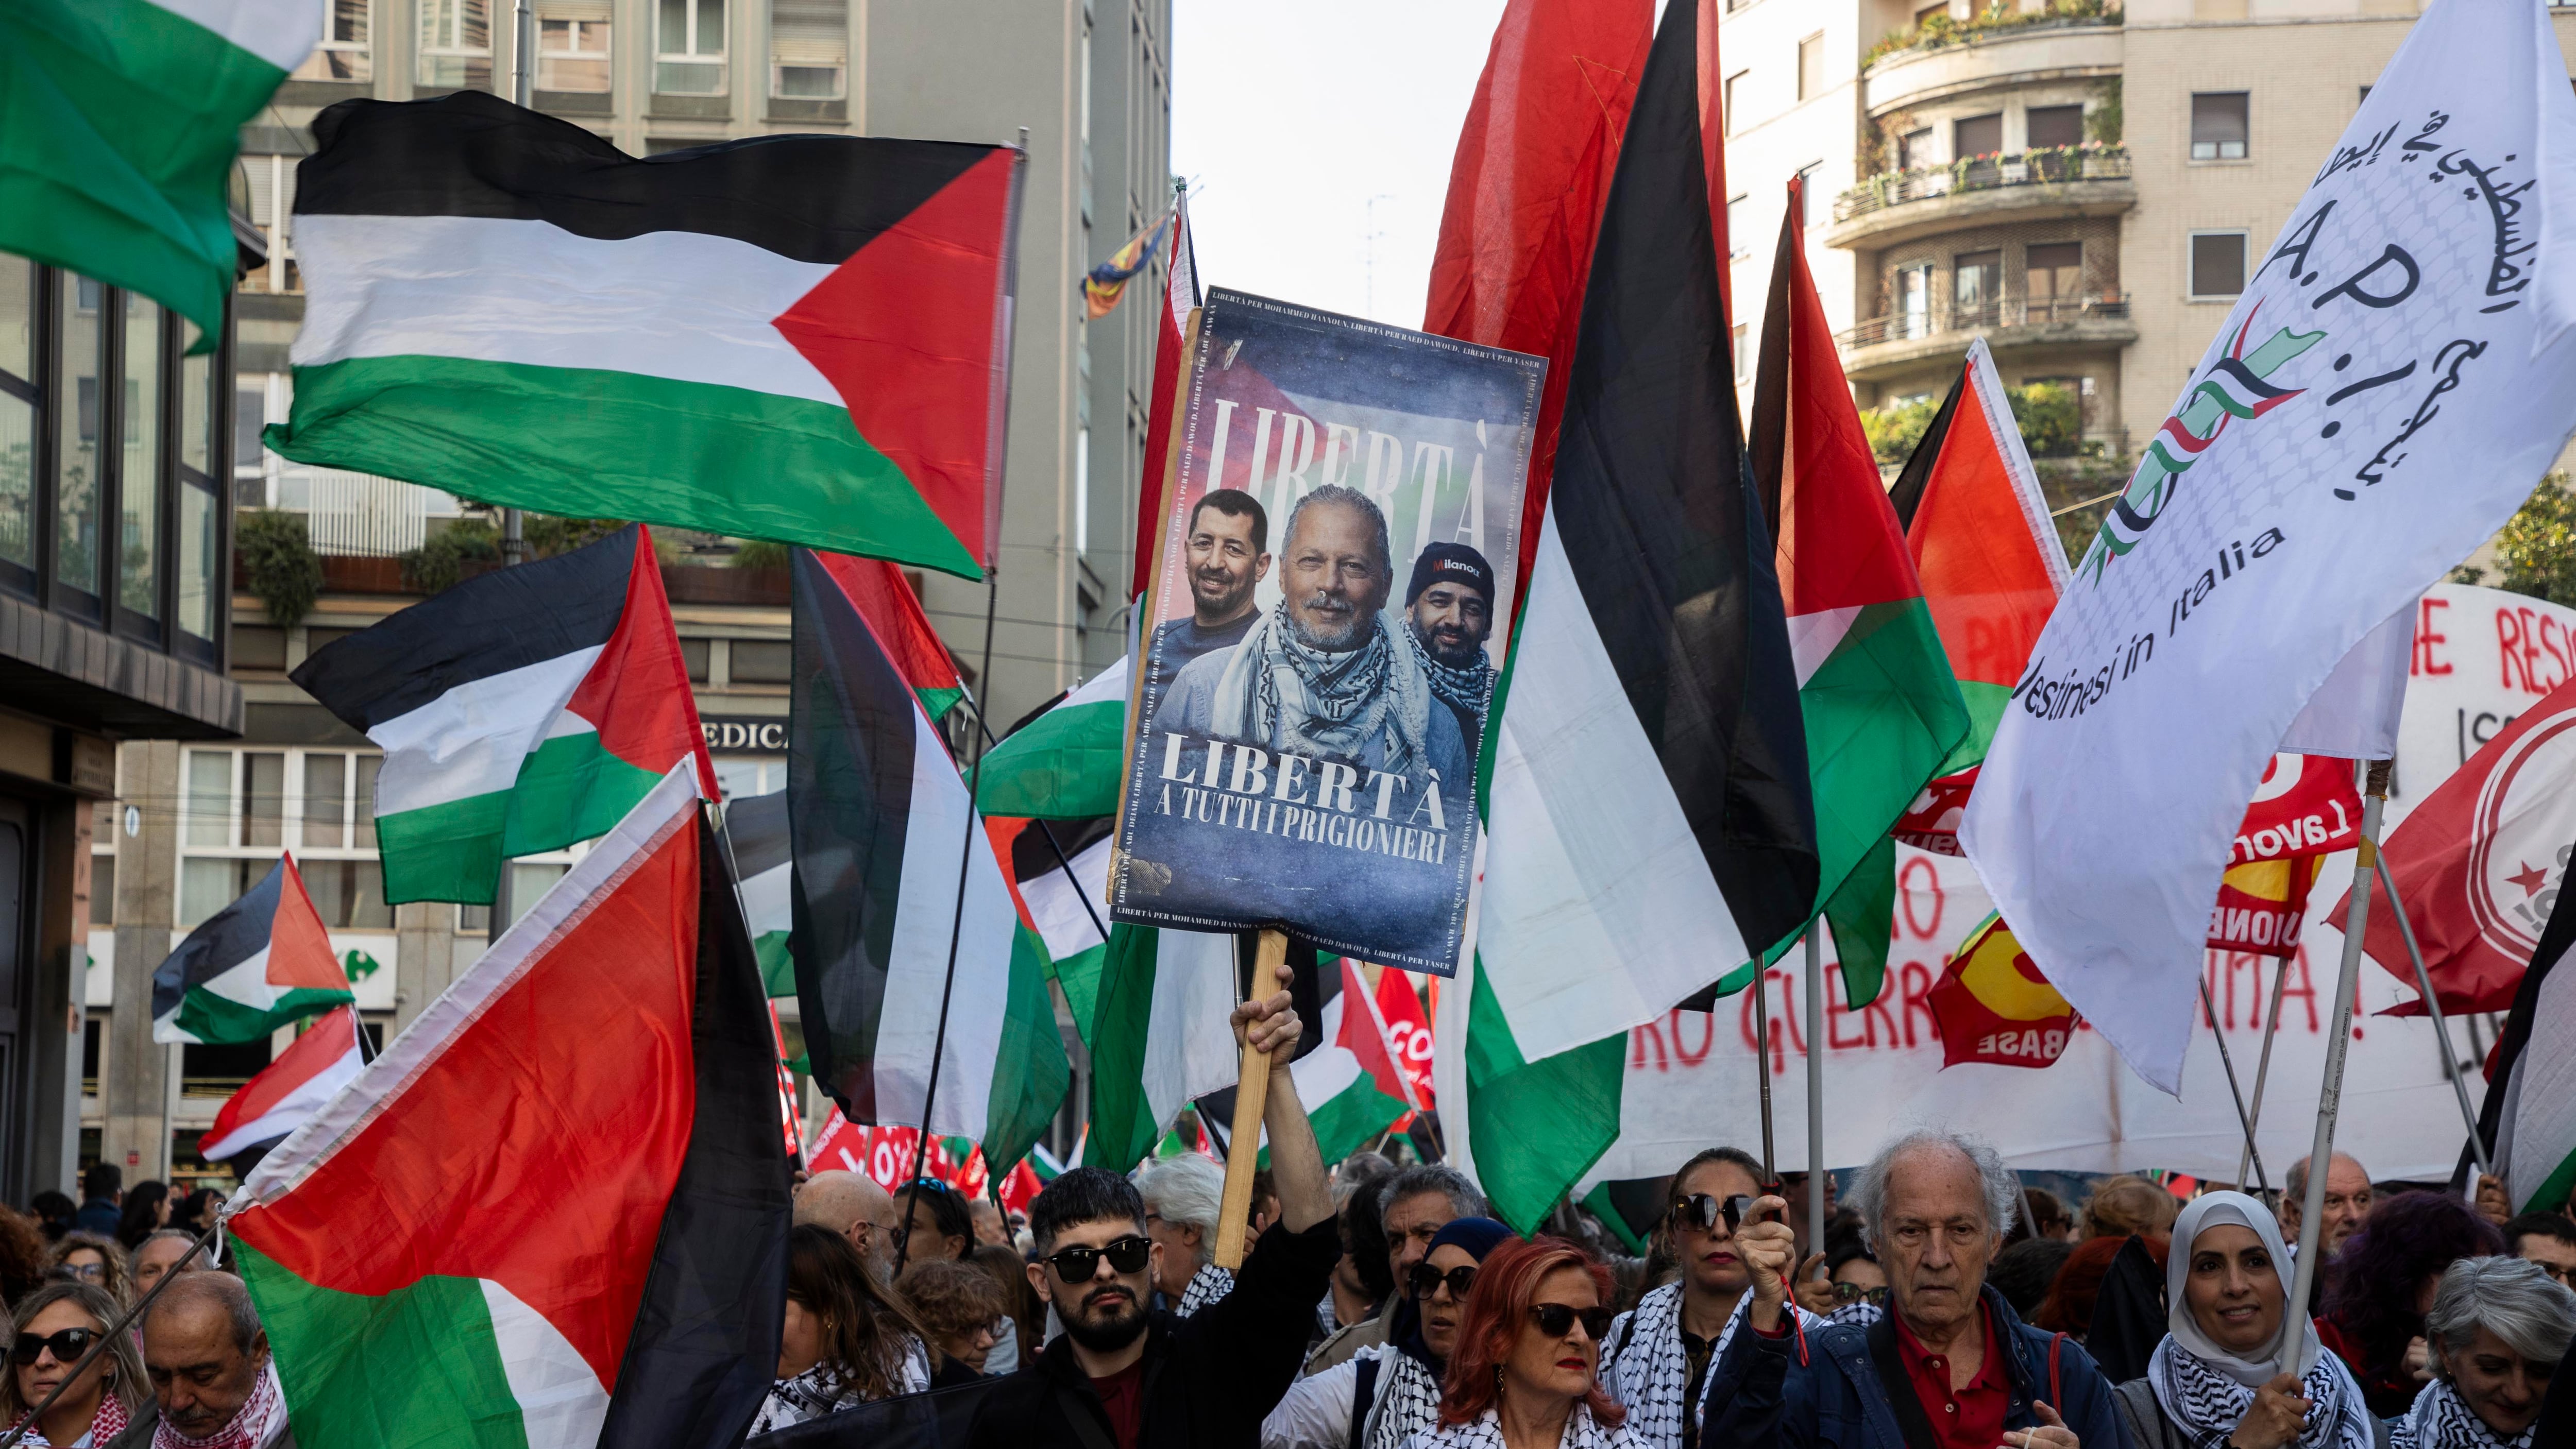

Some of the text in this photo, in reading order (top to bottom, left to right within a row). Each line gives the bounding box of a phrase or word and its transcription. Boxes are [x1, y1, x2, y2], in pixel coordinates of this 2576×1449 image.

[2401, 109, 2450, 163] في
[2429, 148, 2538, 314] الفلسطيني
[1204, 303, 1217, 337] RAWAA
[1211, 289, 1246, 305] LIBERTÀ
[1247, 298, 1262, 309] PER
[1264, 302, 1310, 320] MOHAMMED
[1350, 321, 1384, 336] LIBERTÀ
[1384, 329, 1400, 339] PER
[1401, 332, 1422, 344] RAED
[1462, 344, 1497, 361] LIBERTÀ
[1497, 353, 1513, 364] PER
[1514, 356, 1540, 369] YASER
[1200, 337, 1210, 355] ABU
[1197, 355, 1207, 373] PER
[1191, 373, 1205, 410] LIBERTÀ
[1520, 411, 1530, 428] PER
[1181, 453, 1192, 476] RAED
[1205, 398, 1488, 565] LIBERTÀ
[1179, 478, 1189, 495] PER
[1172, 496, 1185, 532] LIBERTÀ
[1506, 513, 1516, 530] PER
[1158, 577, 1174, 628] MOHAMMED
[1156, 629, 1165, 646] PER
[2010, 527, 2286, 721] lestinesi in Italia
[1149, 647, 1163, 684] LIBERTÀ
[1145, 687, 1157, 715] SALEH
[701, 722, 789, 749] EDIC
[1141, 715, 1152, 739] ABDU
[1139, 741, 1148, 758] PER
[1132, 759, 1146, 797] LIBERTÀ
[1158, 732, 1449, 831] LIBERTÀ
[1467, 789, 1477, 811] RAED
[1125, 830, 1134, 846] ABU
[1154, 783, 1448, 865] A TUTTI I PRIGIONIERI
[1115, 866, 1130, 904] LIBERTÀ
[1455, 854, 1468, 891] LIBERTÀ
[1452, 891, 1462, 909] PER
[1449, 910, 1459, 928] ABU
[1116, 904, 1153, 919] LIBERTÀ
[1153, 910, 1170, 920] PER
[1171, 912, 1219, 929] MOHAMMED
[1312, 934, 1334, 946] RAED
[1373, 948, 1408, 962] LIBERTÀ
[1407, 956, 1424, 965] PER
[1423, 958, 1450, 970] YASER
[1444, 928, 1456, 960] RAWAA
[1740, 953, 1953, 1076] GUERR
